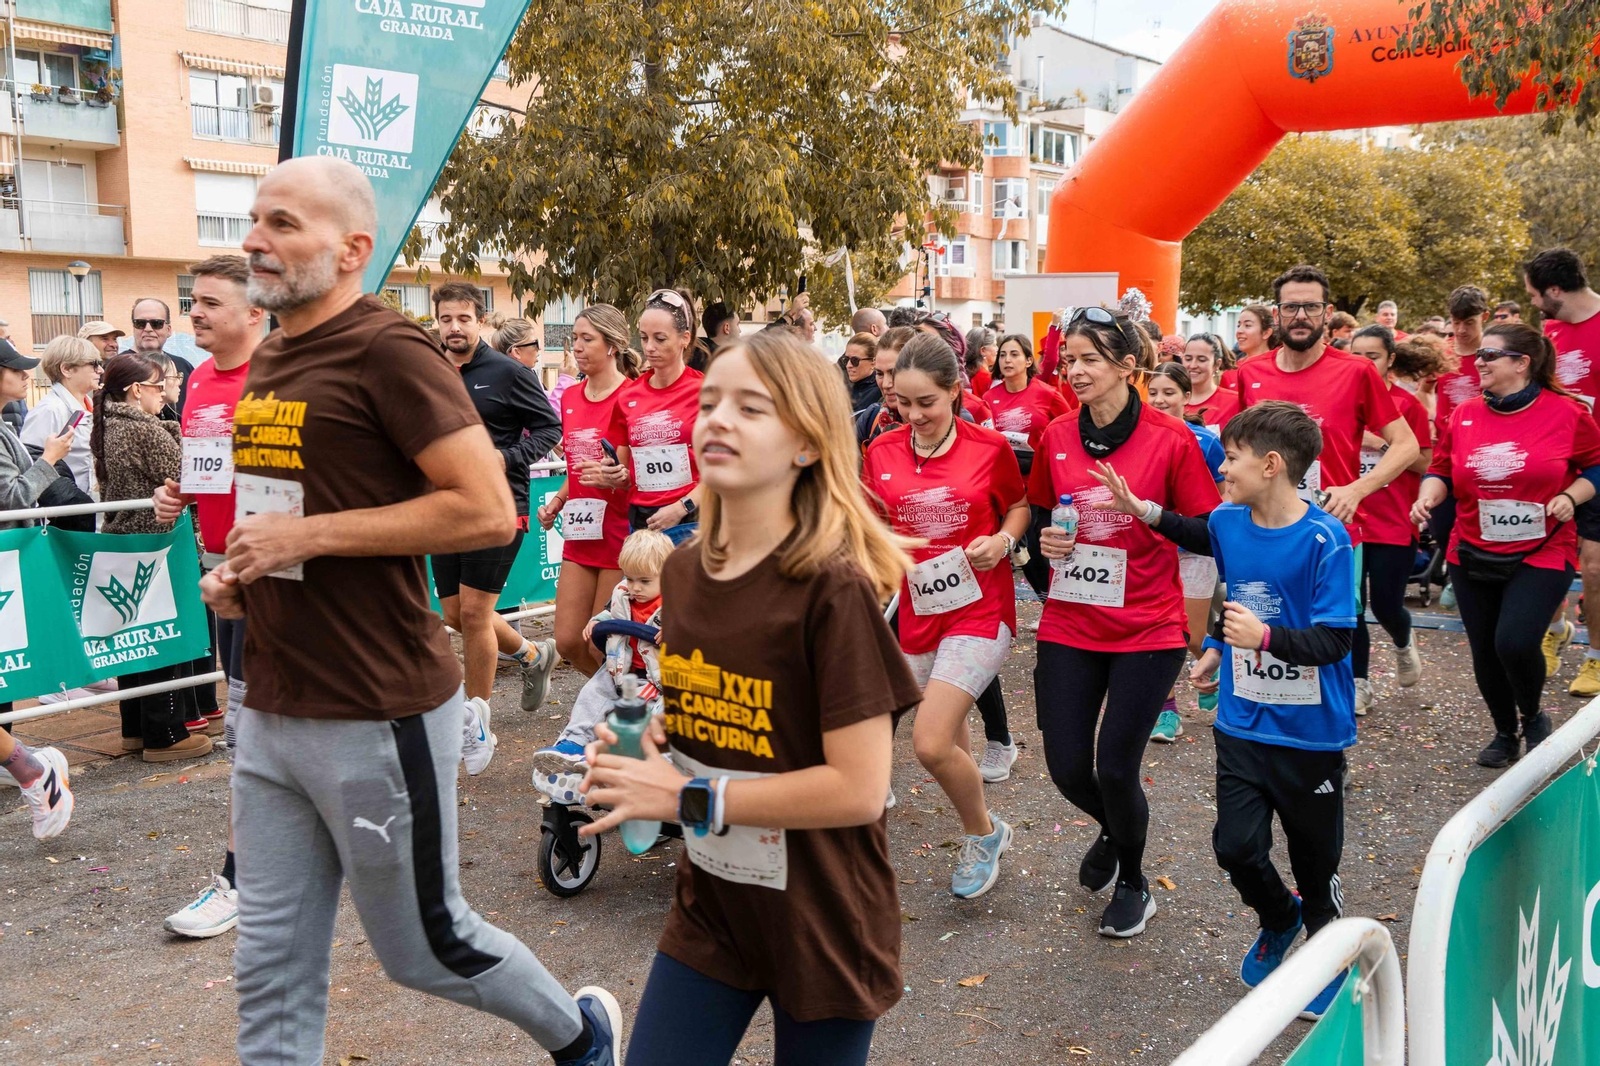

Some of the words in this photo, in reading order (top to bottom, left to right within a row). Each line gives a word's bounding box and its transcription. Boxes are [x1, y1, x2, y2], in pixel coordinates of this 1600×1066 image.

[355, 0, 405, 18] CAJA
[410, 3, 483, 30] RURAL
[380, 19, 454, 41] GRANADA
[316, 65, 333, 142] fundación
[355, 150, 411, 170] RURAL
[274, 401, 308, 427] XXII
[250, 425, 303, 447] CARRERA
[193, 457, 223, 472] 1109
[646, 461, 673, 475] 810
[568, 512, 594, 525] 344
[900, 513, 969, 523] HUMANIDAD
[1079, 513, 1133, 524] MANIDAD
[1490, 514, 1534, 526] 1404
[914, 573, 960, 597] 1400
[1064, 565, 1110, 584] 1402
[113, 623, 181, 651] RURAL
[93, 645, 159, 669] GRANADA
[1244, 659, 1300, 681] 1405
[721, 671, 773, 710] XXII
[680, 691, 773, 732] CARRERA
